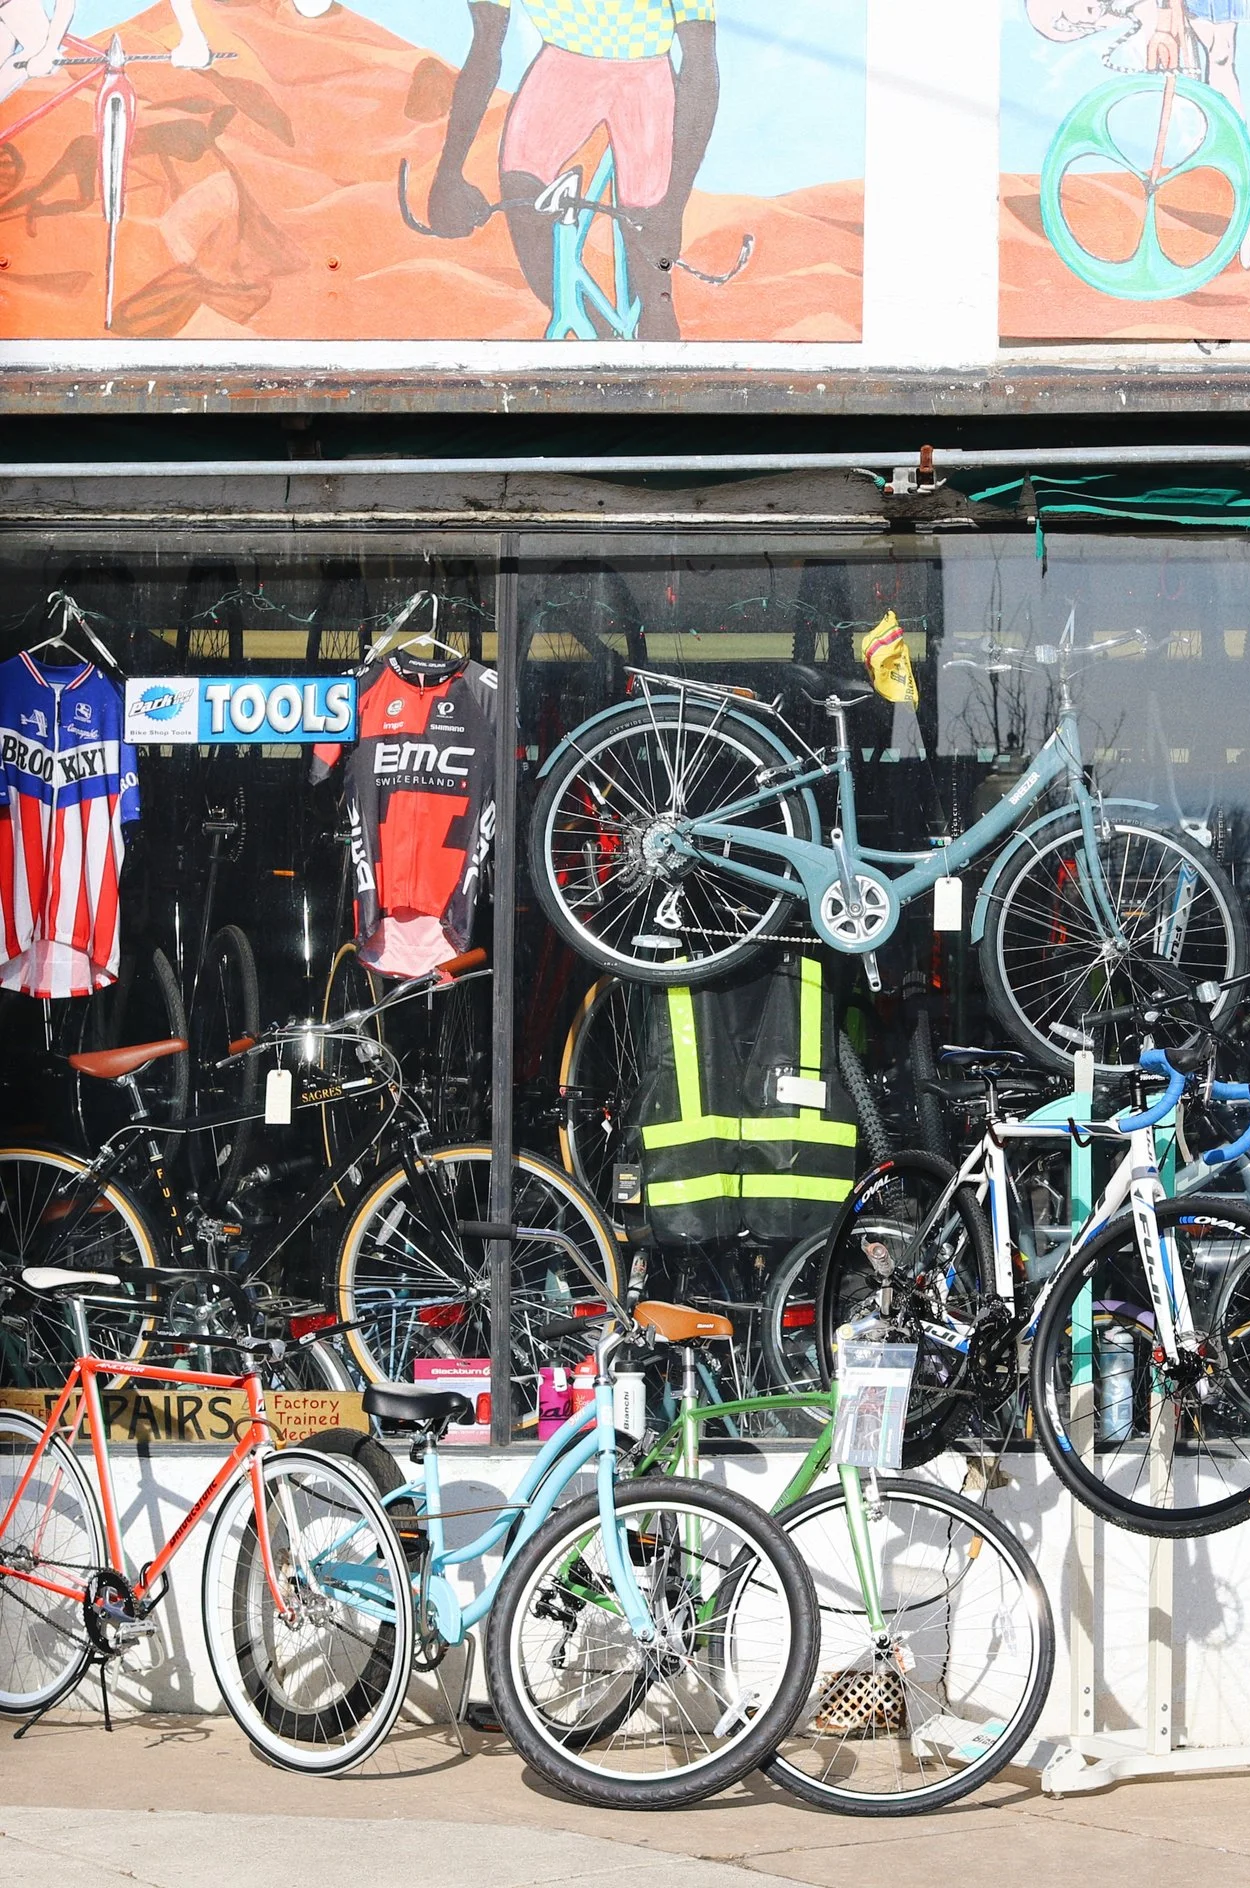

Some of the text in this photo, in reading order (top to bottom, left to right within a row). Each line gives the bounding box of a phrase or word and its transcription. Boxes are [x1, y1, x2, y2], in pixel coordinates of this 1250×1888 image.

[204, 683, 351, 734] TOOLS
[430, 723, 466, 733] SHIMANO
[609, 719, 643, 735] CITYWIDE
[373, 740, 476, 777] BMC
[1008, 771, 1041, 805] BREEZER
[861, 1173, 895, 1203] OVAL
[156, 1168, 183, 1236] FUJI
[1193, 1215, 1250, 1236] OVAL
[1138, 1212, 1162, 1305] FUJI
[94, 1362, 146, 1373] ANCHOR
[274, 1394, 340, 1412] Factory
[276, 1411, 340, 1426] Trained
